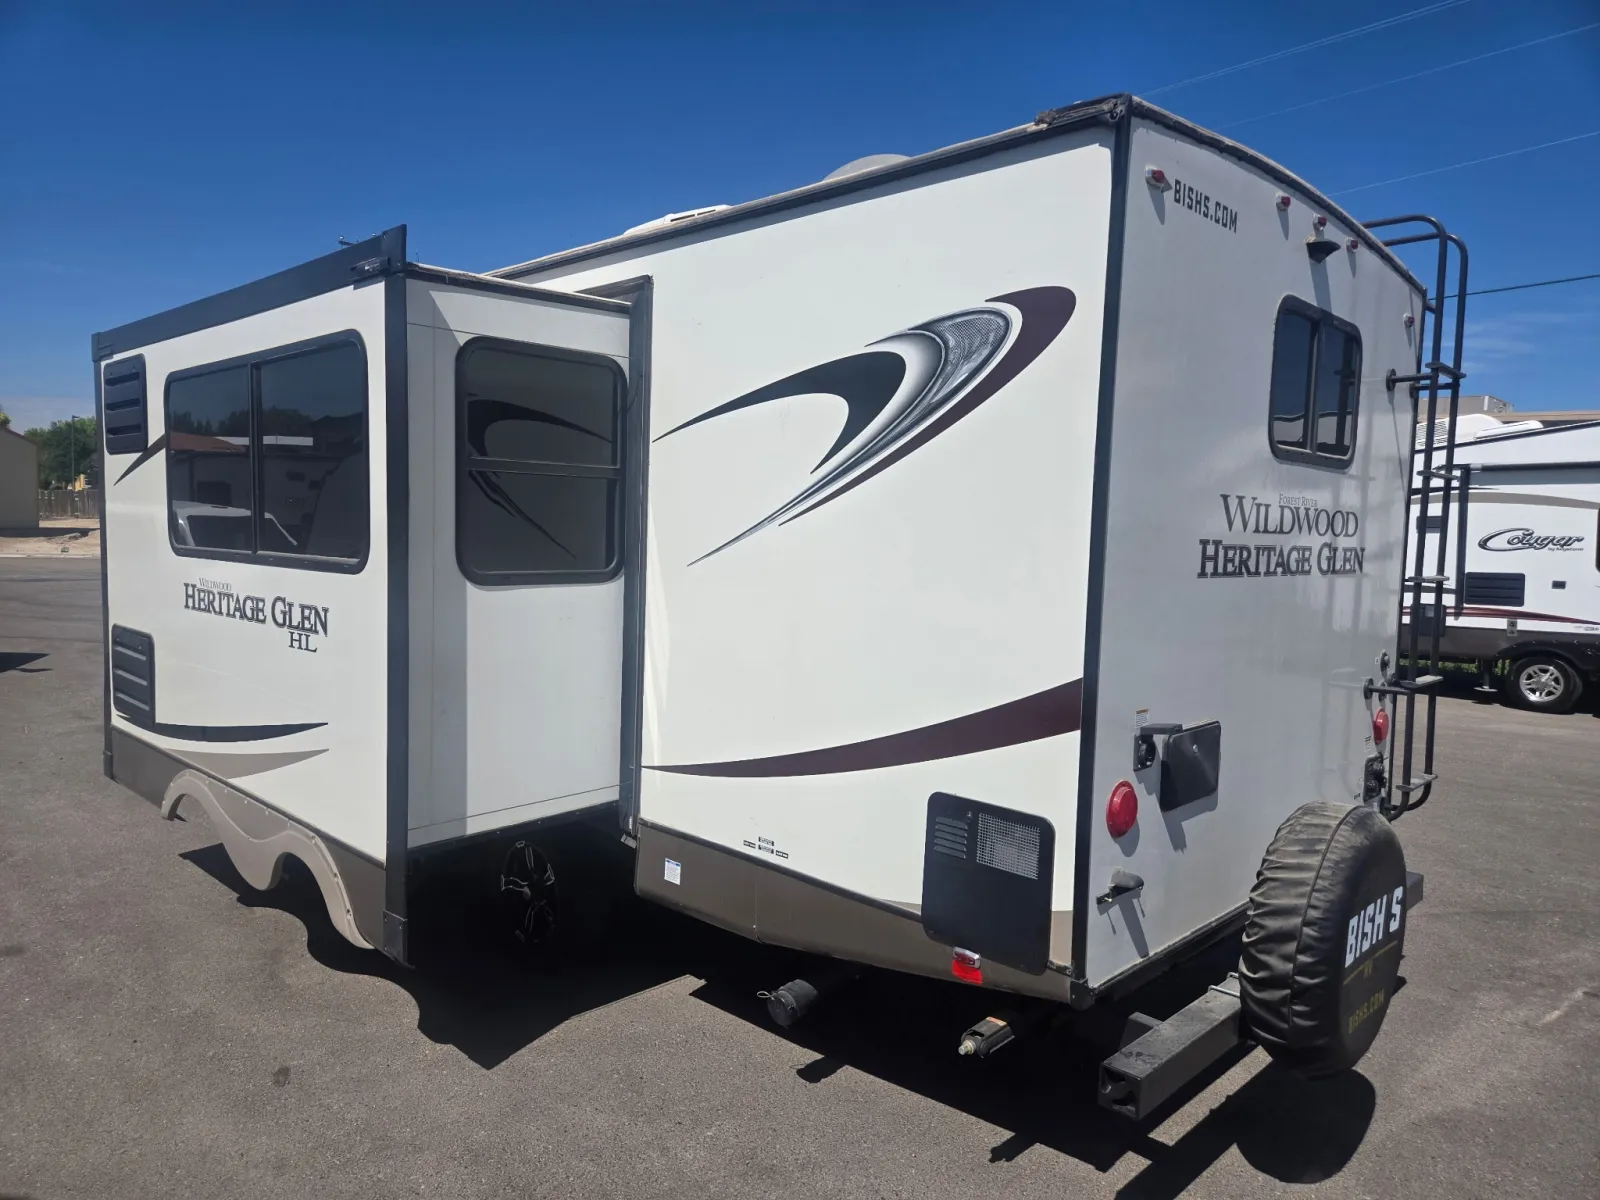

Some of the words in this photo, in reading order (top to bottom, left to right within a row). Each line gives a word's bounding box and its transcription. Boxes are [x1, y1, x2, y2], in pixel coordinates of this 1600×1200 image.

[1174, 178, 1238, 234] BISHS.COM
[1219, 493, 1359, 538] WILDWOOD
[1278, 493, 1301, 506] FOREST
[1301, 496, 1318, 508] RIVER
[1477, 527, 1585, 552] Cougar
[1197, 538, 1313, 579] HERITAGE
[1317, 541, 1366, 576] GLEN
[198, 577, 232, 592] WILDWOOD
[183, 582, 267, 624] HERITAGE
[271, 595, 330, 638] GLEN
[288, 630, 318, 653] HL
